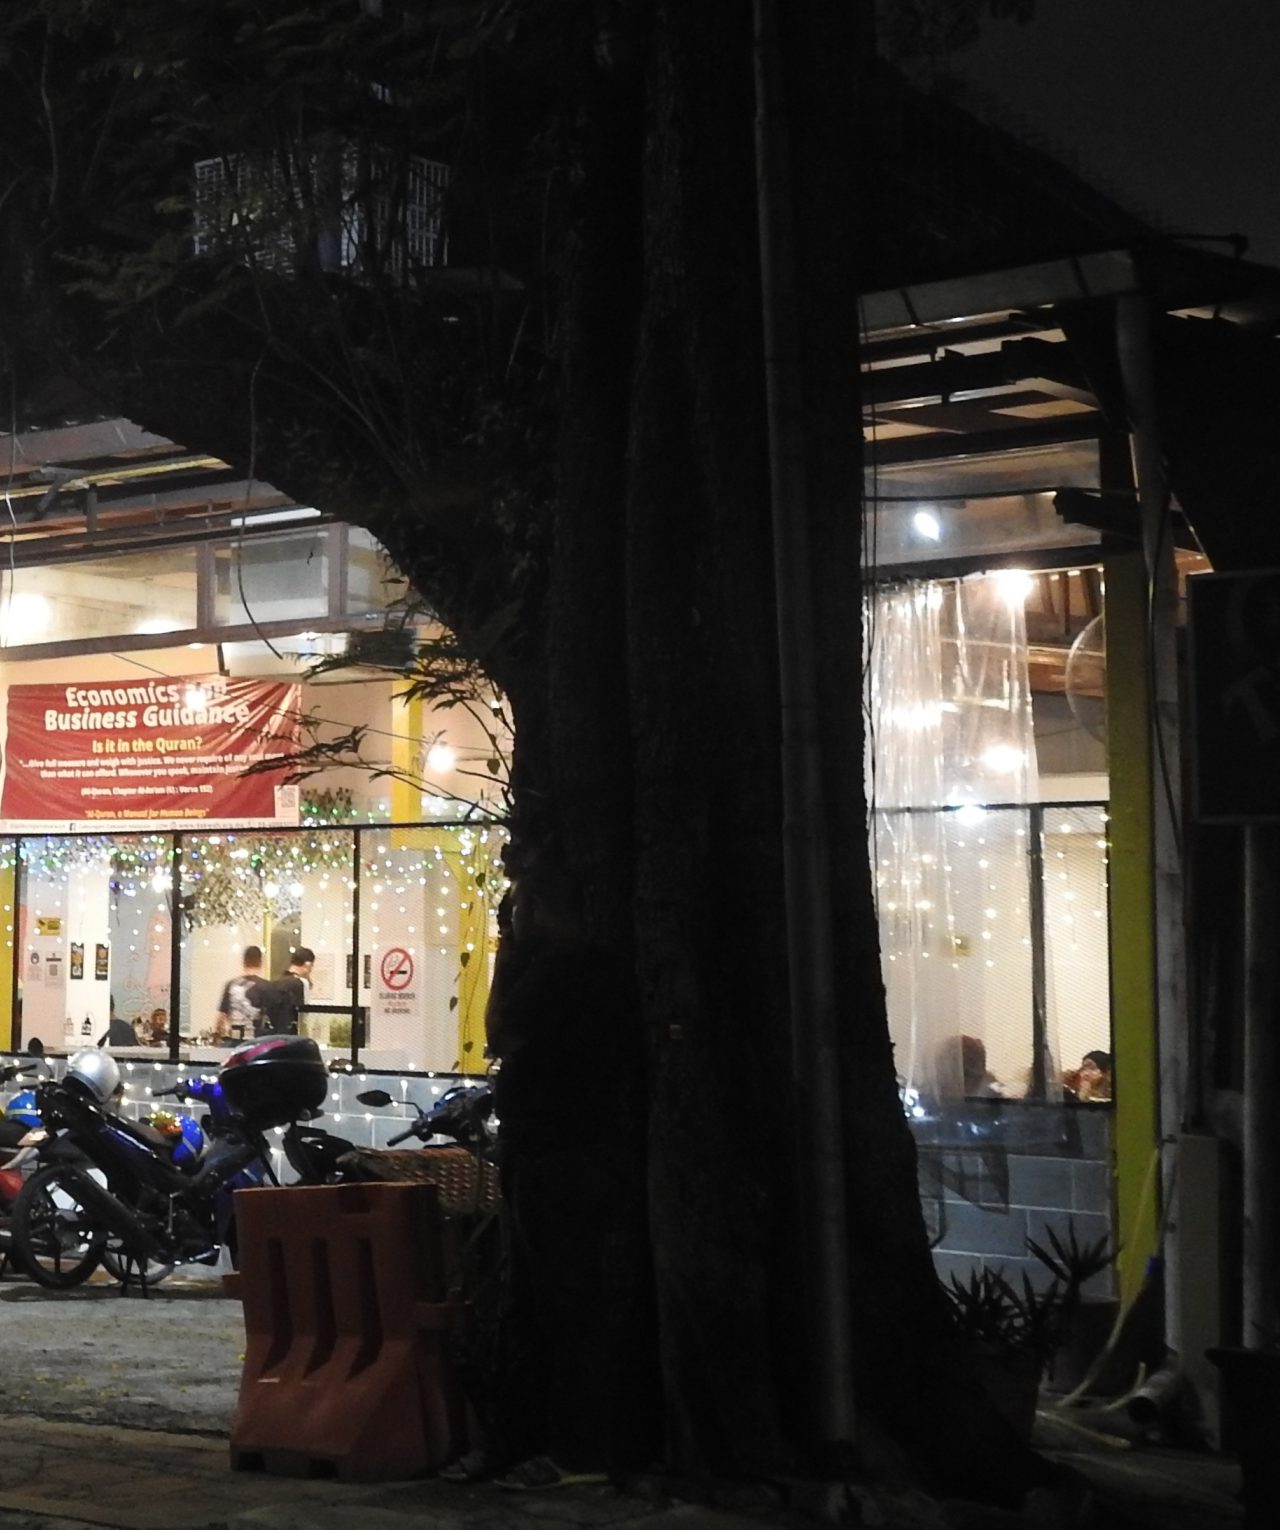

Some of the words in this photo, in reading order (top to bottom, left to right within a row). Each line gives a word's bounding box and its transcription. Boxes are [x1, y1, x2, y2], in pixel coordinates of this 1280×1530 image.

[65, 681, 180, 707] Economics
[44, 707, 138, 731] Business
[143, 702, 250, 727] Guidance
[92, 739, 103, 753] Is
[105, 738, 115, 753] it
[117, 738, 130, 753] in
[132, 738, 153, 752] the
[156, 736, 203, 754] Quran?
